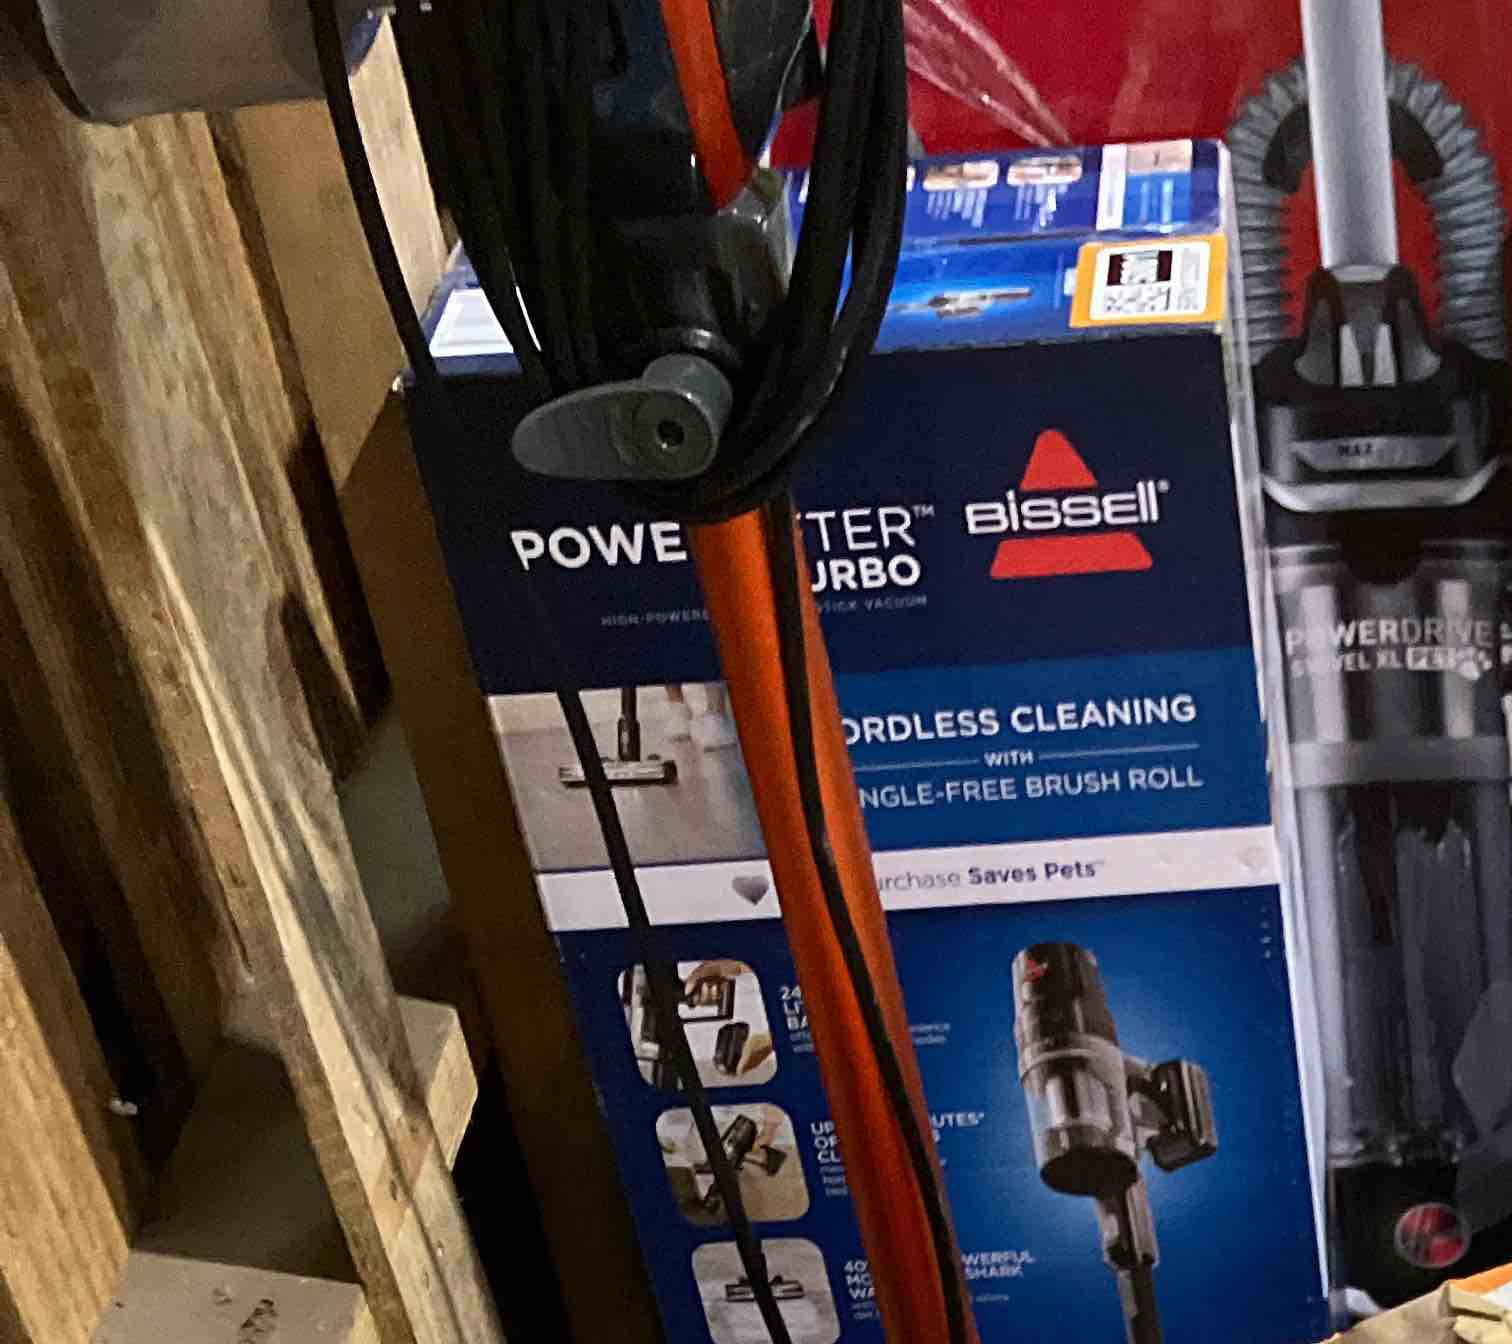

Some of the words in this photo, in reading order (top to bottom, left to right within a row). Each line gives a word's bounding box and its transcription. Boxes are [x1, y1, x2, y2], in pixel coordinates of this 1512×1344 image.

[810, 553, 922, 592] URBO
[843, 706, 1001, 746] ORDLESS
[1010, 694, 1197, 734] CLEANING
[983, 749, 1035, 768] WITH
[858, 777, 1018, 810] NGLE-FREE
[1025, 769, 1121, 799] BRUSH
[1128, 765, 1205, 789] ROLL
[876, 870, 961, 892] urchase
[967, 862, 1037, 886] Saves
